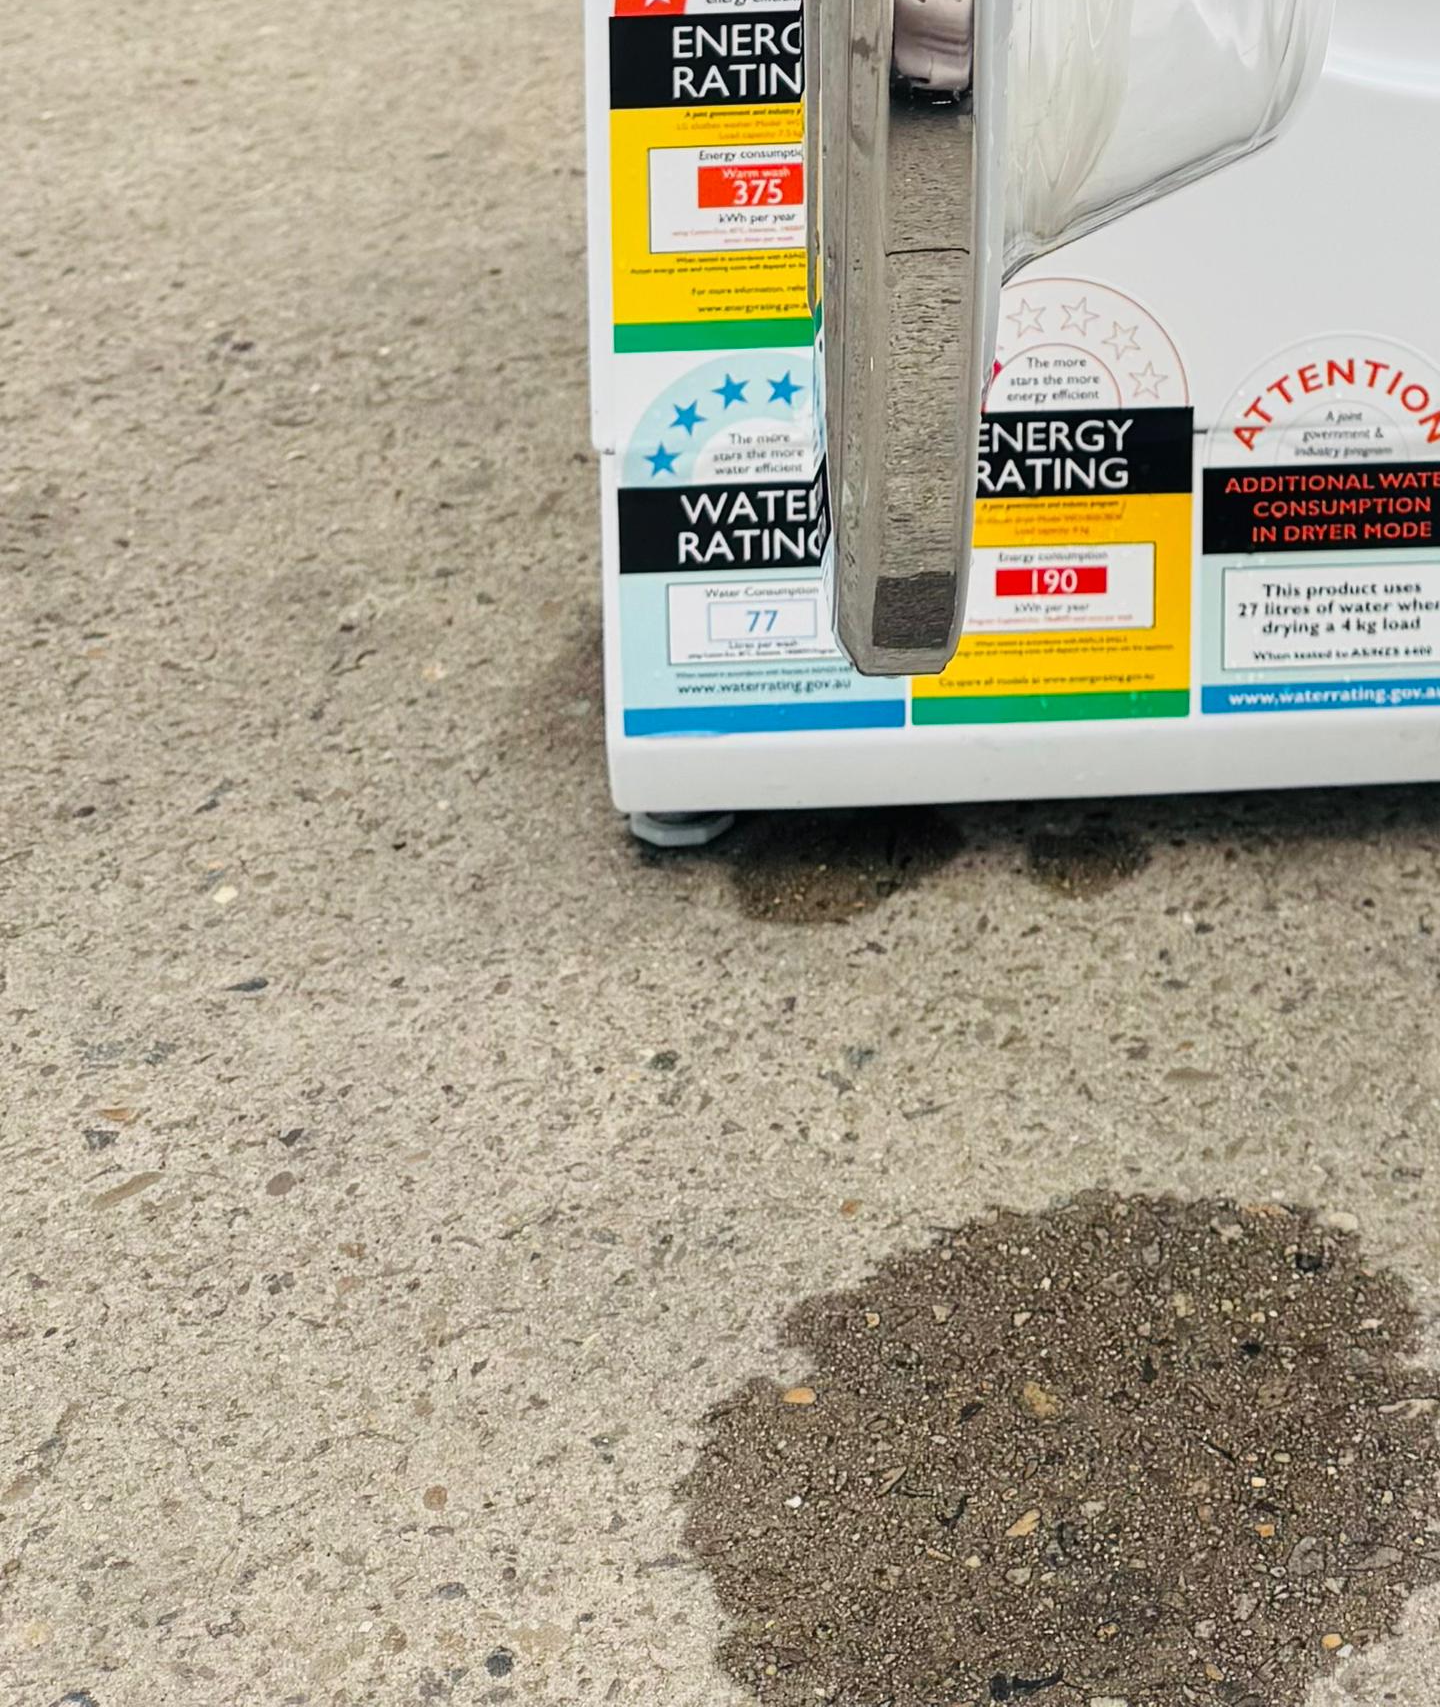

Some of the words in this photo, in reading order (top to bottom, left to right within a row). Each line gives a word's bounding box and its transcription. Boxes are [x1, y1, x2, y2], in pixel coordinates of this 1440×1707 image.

[672, 22, 802, 59] ENERG
[672, 62, 801, 99] RATIN
[699, 149, 736, 162] Energy
[741, 147, 802, 160] consumpti
[722, 168, 760, 179] Warm
[762, 167, 790, 177] wash
[732, 178, 783, 205] 375
[719, 213, 747, 224] kWh
[750, 214, 768, 227] per
[774, 213, 796, 223] year
[1026, 357, 1049, 369] The
[1053, 358, 1086, 367] more
[1010, 376, 1039, 386] stars
[1043, 374, 1063, 385] the
[1067, 376, 1100, 384] more
[1007, 391, 1047, 404] energy
[1052, 390, 1099, 400] efficient
[1326, 411, 1334, 421] A
[1335, 411, 1363, 424] joint
[728, 433, 751, 445] The
[757, 434, 790, 444] more
[978, 419, 1134, 453] ENERGY
[1302, 427, 1370, 442] government
[1375, 427, 1384, 438] &
[713, 452, 743, 462] stars
[746, 449, 767, 459] the
[771, 449, 804, 458] more
[1294, 446, 1339, 458] industry
[1343, 446, 1393, 458] program
[715, 465, 751, 475] water
[755, 463, 802, 474] efficient
[977, 458, 1129, 492] RATING
[1225, 474, 1375, 494] ADDITIONAL
[1253, 497, 1431, 518] CONSUMPTION
[1252, 526, 1276, 542] IN
[1284, 525, 1356, 541] DRYER
[1364, 521, 1432, 539] MODE
[999, 552, 1034, 563] Energy
[1031, 569, 1078, 594] 190
[705, 588, 740, 598] Water
[744, 586, 819, 597] Consumption
[1262, 583, 1301, 598] This
[1306, 582, 1377, 601] product
[1383, 581, 1422, 594] uses
[1045, 603, 1062, 612] per
[1067, 604, 1089, 612] year
[1238, 602, 1258, 618] 27
[1264, 601, 1309, 615] litres
[1316, 600, 1334, 615] of
[1338, 600, 1392, 613] water
[746, 609, 779, 633] 77
[1262, 620, 1319, 638] drying
[1326, 623, 1335, 632] a
[1342, 618, 1350, 631] 4
[1356, 618, 1377, 635] kg
[1382, 616, 1421, 630] load
[757, 641, 773, 649] per
[776, 640, 798, 648] wash
[1252, 650, 1290, 661] When
[678, 679, 851, 694] www.waterrating.gov.au
